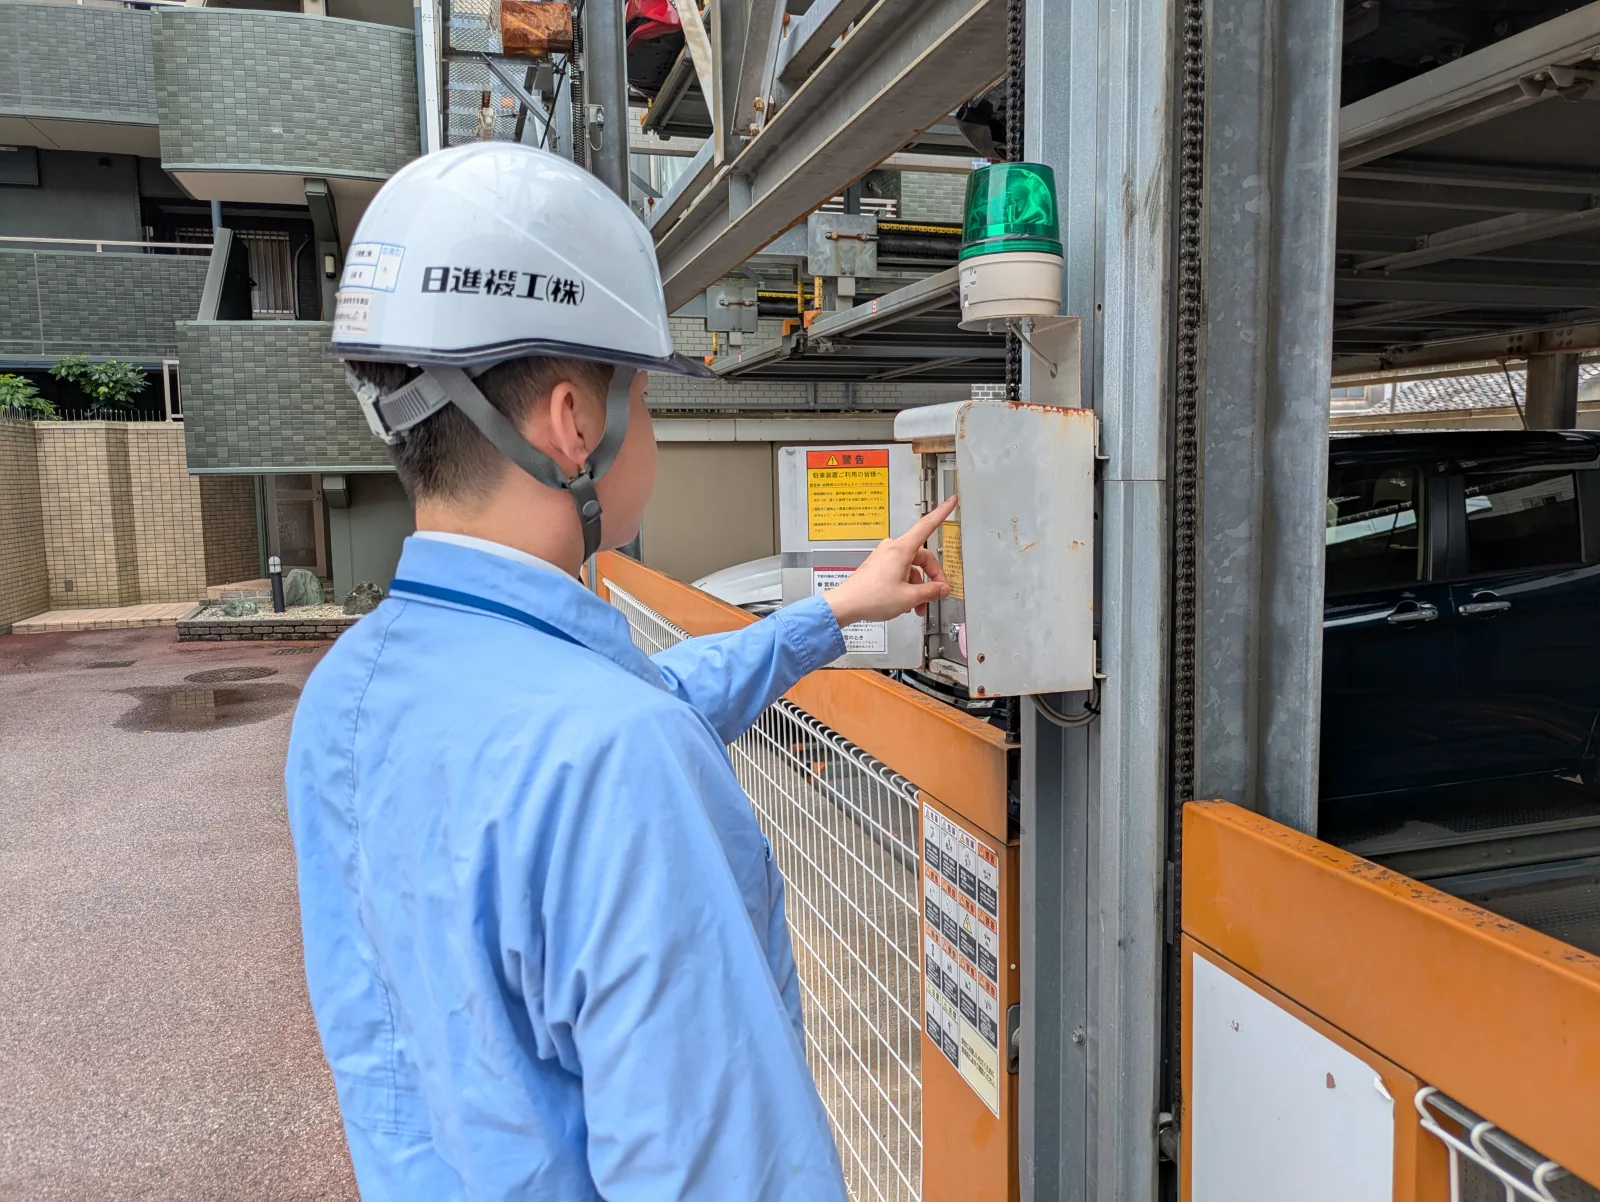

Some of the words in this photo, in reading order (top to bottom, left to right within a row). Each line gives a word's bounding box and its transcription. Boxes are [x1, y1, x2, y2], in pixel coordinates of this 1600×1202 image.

[842, 454, 864, 465] 警告
[813, 471, 883, 479] 駐車装置ご利用の皆様へ
